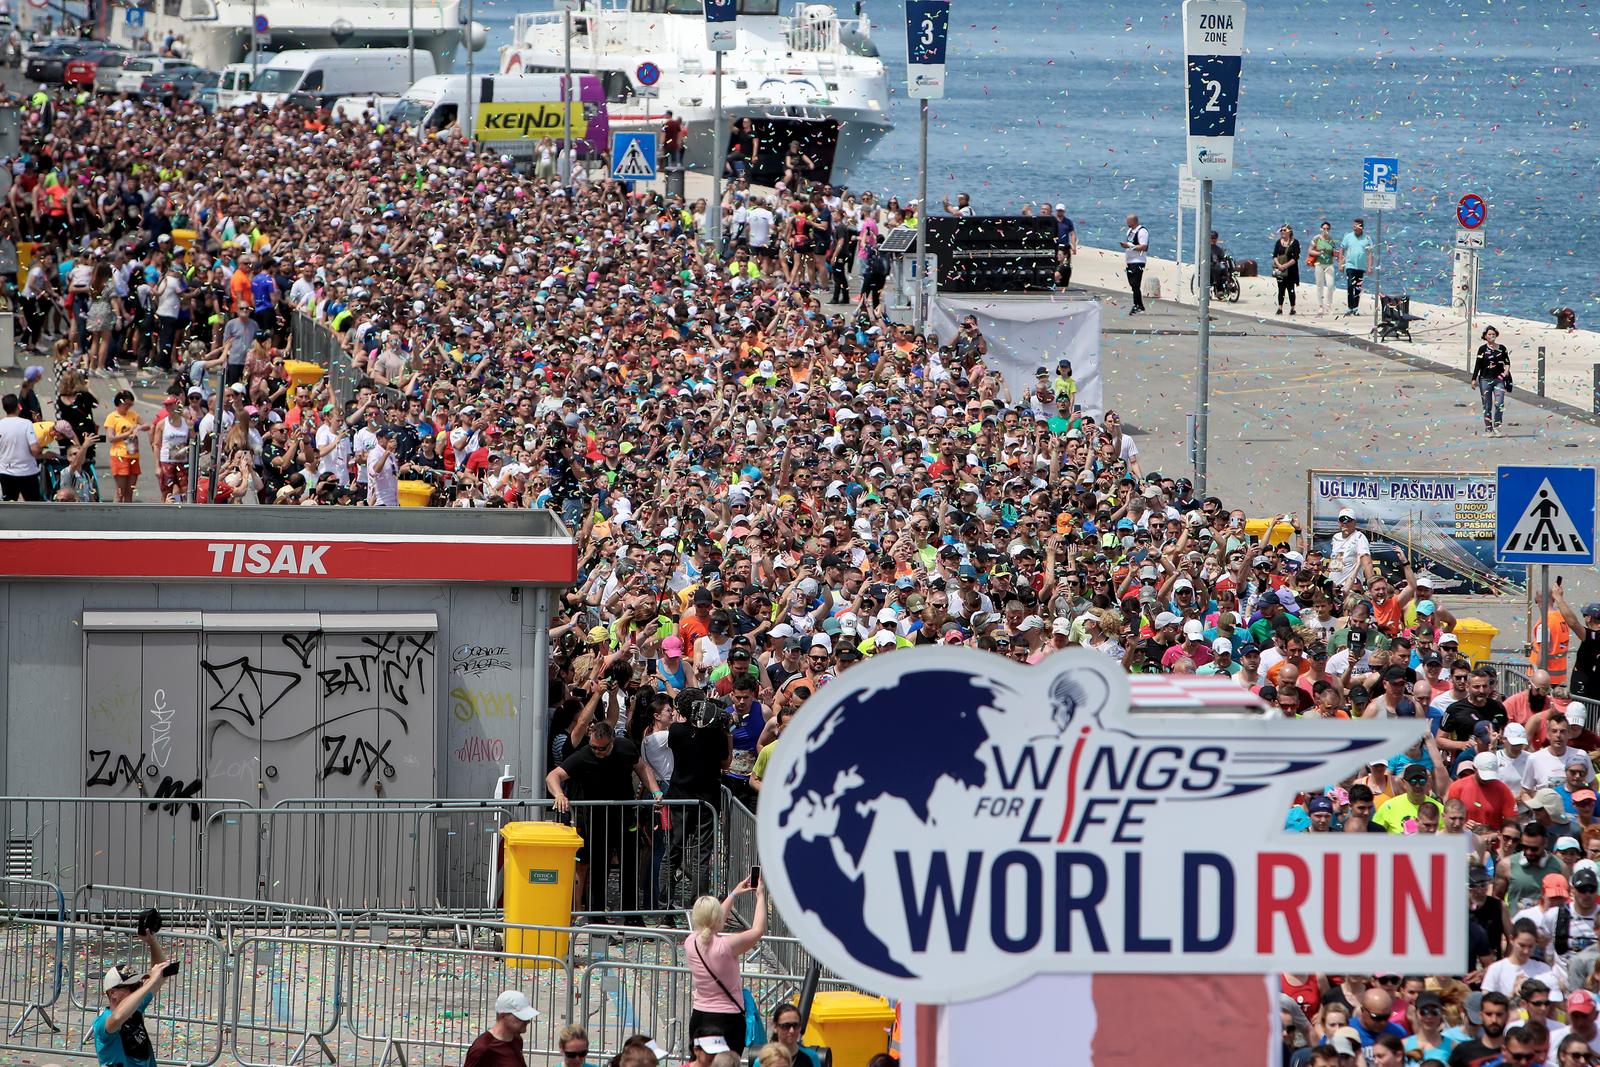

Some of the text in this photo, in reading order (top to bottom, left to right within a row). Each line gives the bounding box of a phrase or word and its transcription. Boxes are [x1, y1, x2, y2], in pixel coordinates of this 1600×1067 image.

[921, 20, 933, 44] 3
[1200, 15, 1233, 29] ZONA
[1204, 32, 1227, 42] ZONE
[1205, 80, 1221, 112] 2
[1373, 164, 1388, 185] P
[1319, 480, 1378, 499] UGLJAN
[1390, 480, 1455, 501] PAŠMAN
[1455, 503, 1488, 511] U NOVU
[207, 543, 332, 575] TISAK
[973, 797, 1024, 817] FOR
[1019, 797, 1158, 843] LIFE
[894, 850, 1446, 956] WORLD RUN
